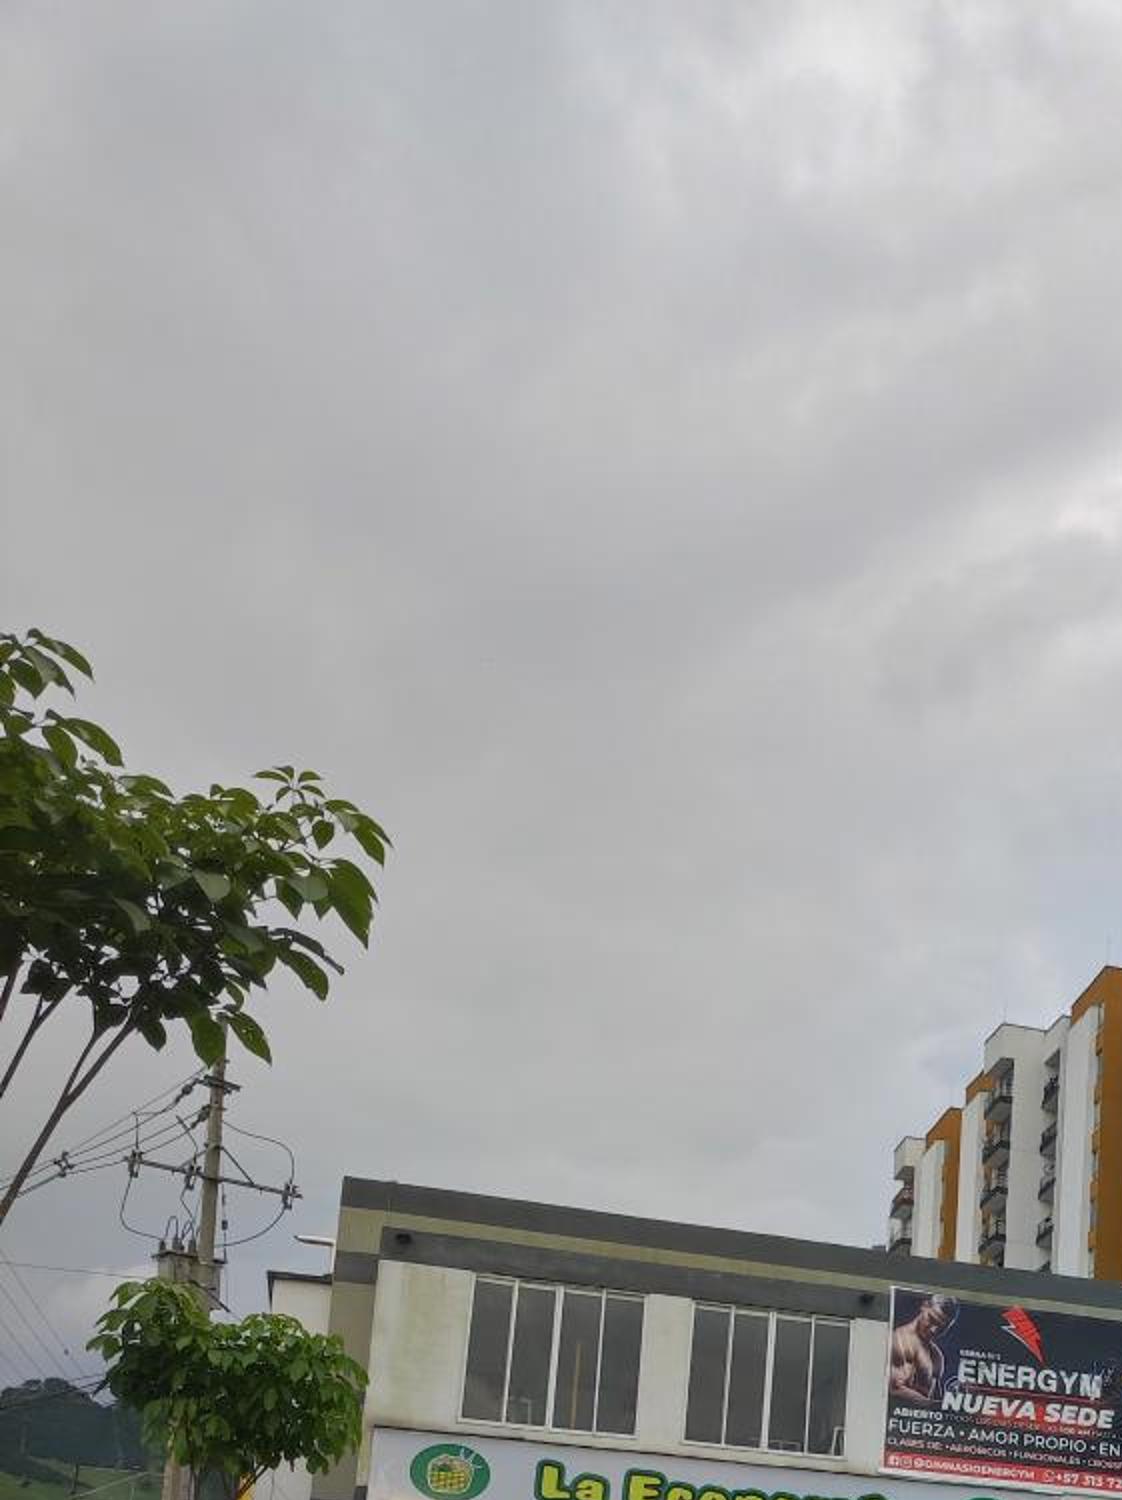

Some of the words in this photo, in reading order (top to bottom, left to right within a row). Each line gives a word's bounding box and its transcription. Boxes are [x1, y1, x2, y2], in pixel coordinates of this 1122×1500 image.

[958, 1358, 1103, 1400] ENERGYM
[893, 1407, 943, 1421] ABIERTO
[942, 1391, 1035, 1421] NUEVA
[1044, 1402, 1114, 1429] SEDE
[888, 1418, 955, 1438] FUERZA
[968, 1428, 1019, 1445] AMOR
[1023, 1434, 1087, 1453] PROPIO
[1013, 1451, 1081, 1464] FUNCIONALES
[1056, 1472, 1079, 1484] +57
